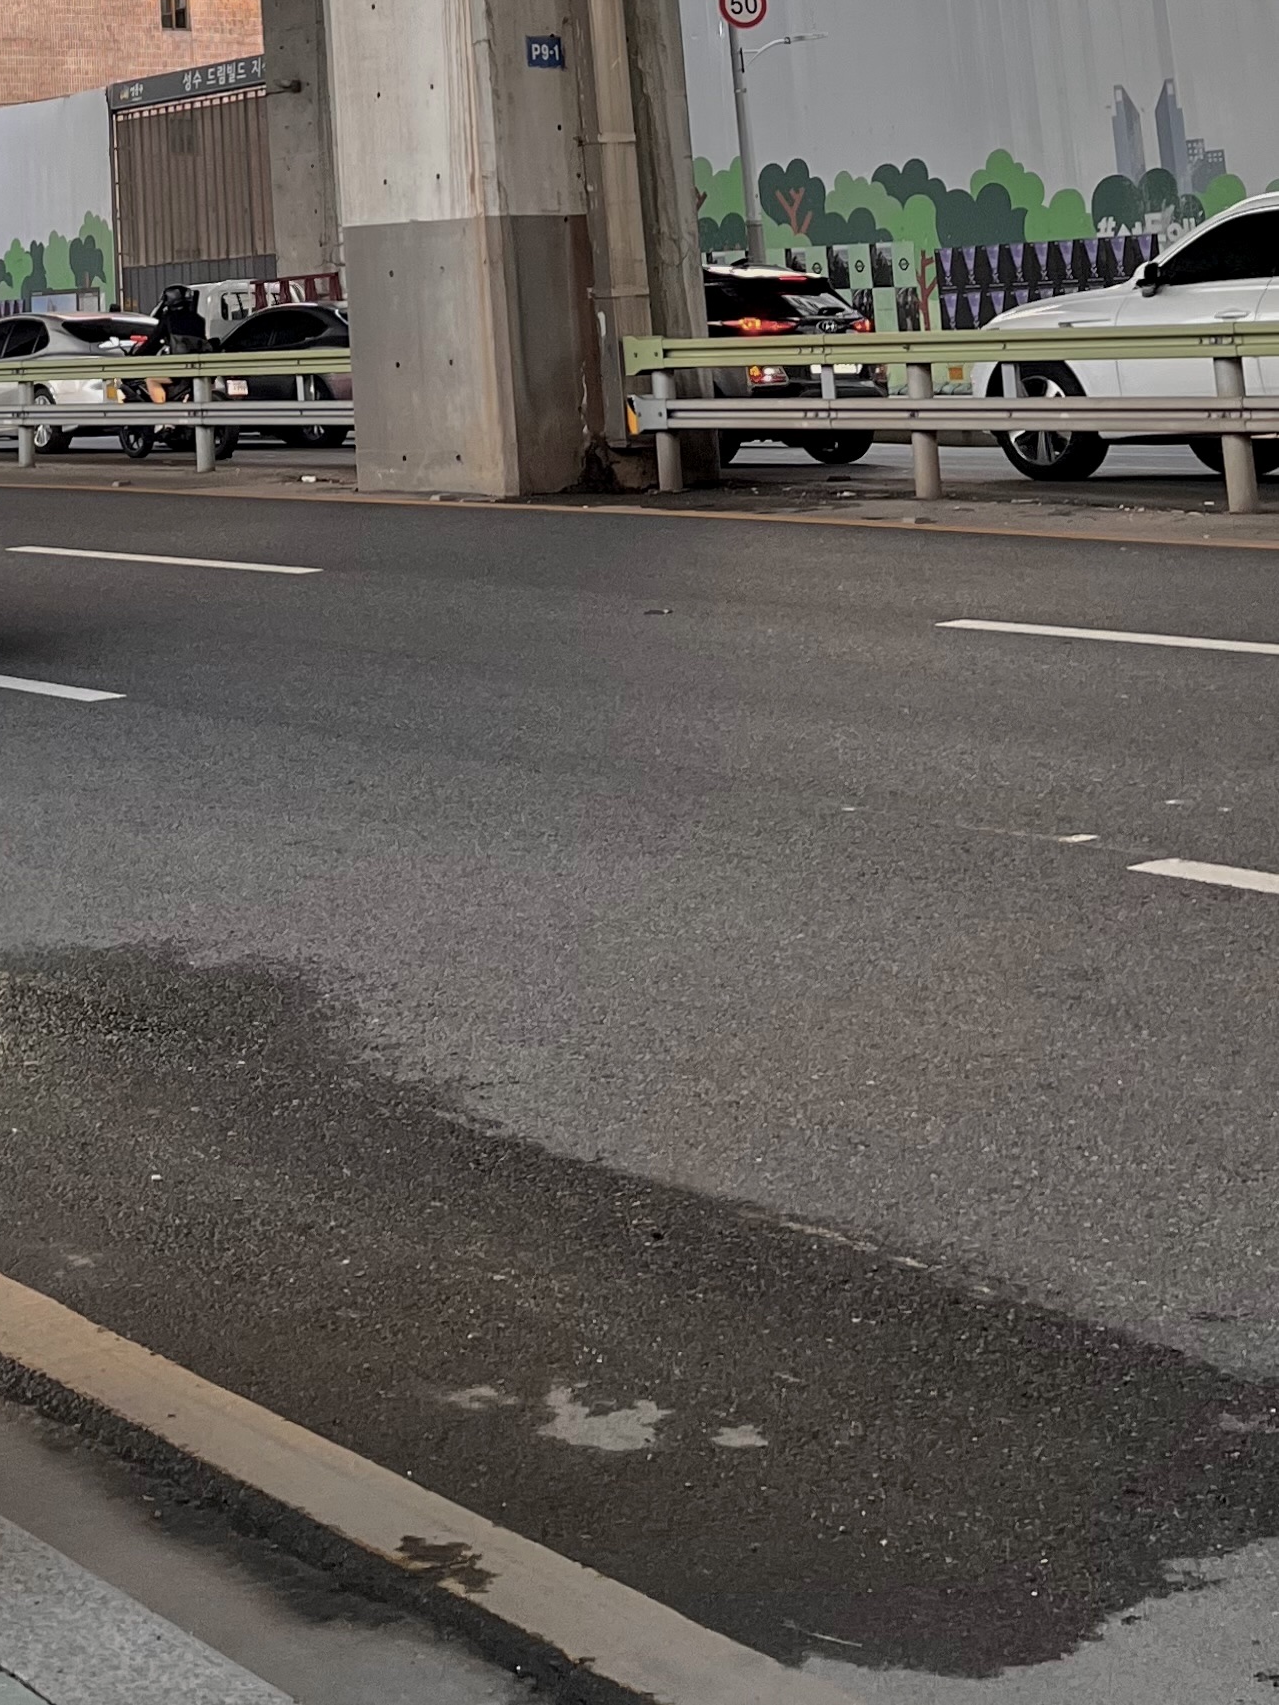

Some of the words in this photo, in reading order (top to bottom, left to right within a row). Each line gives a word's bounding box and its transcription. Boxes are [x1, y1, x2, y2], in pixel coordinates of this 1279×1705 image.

[531, 43, 560, 61] P9-1
[182, 70, 202, 92] 성수
[206, 61, 247, 85] 드림빌드
